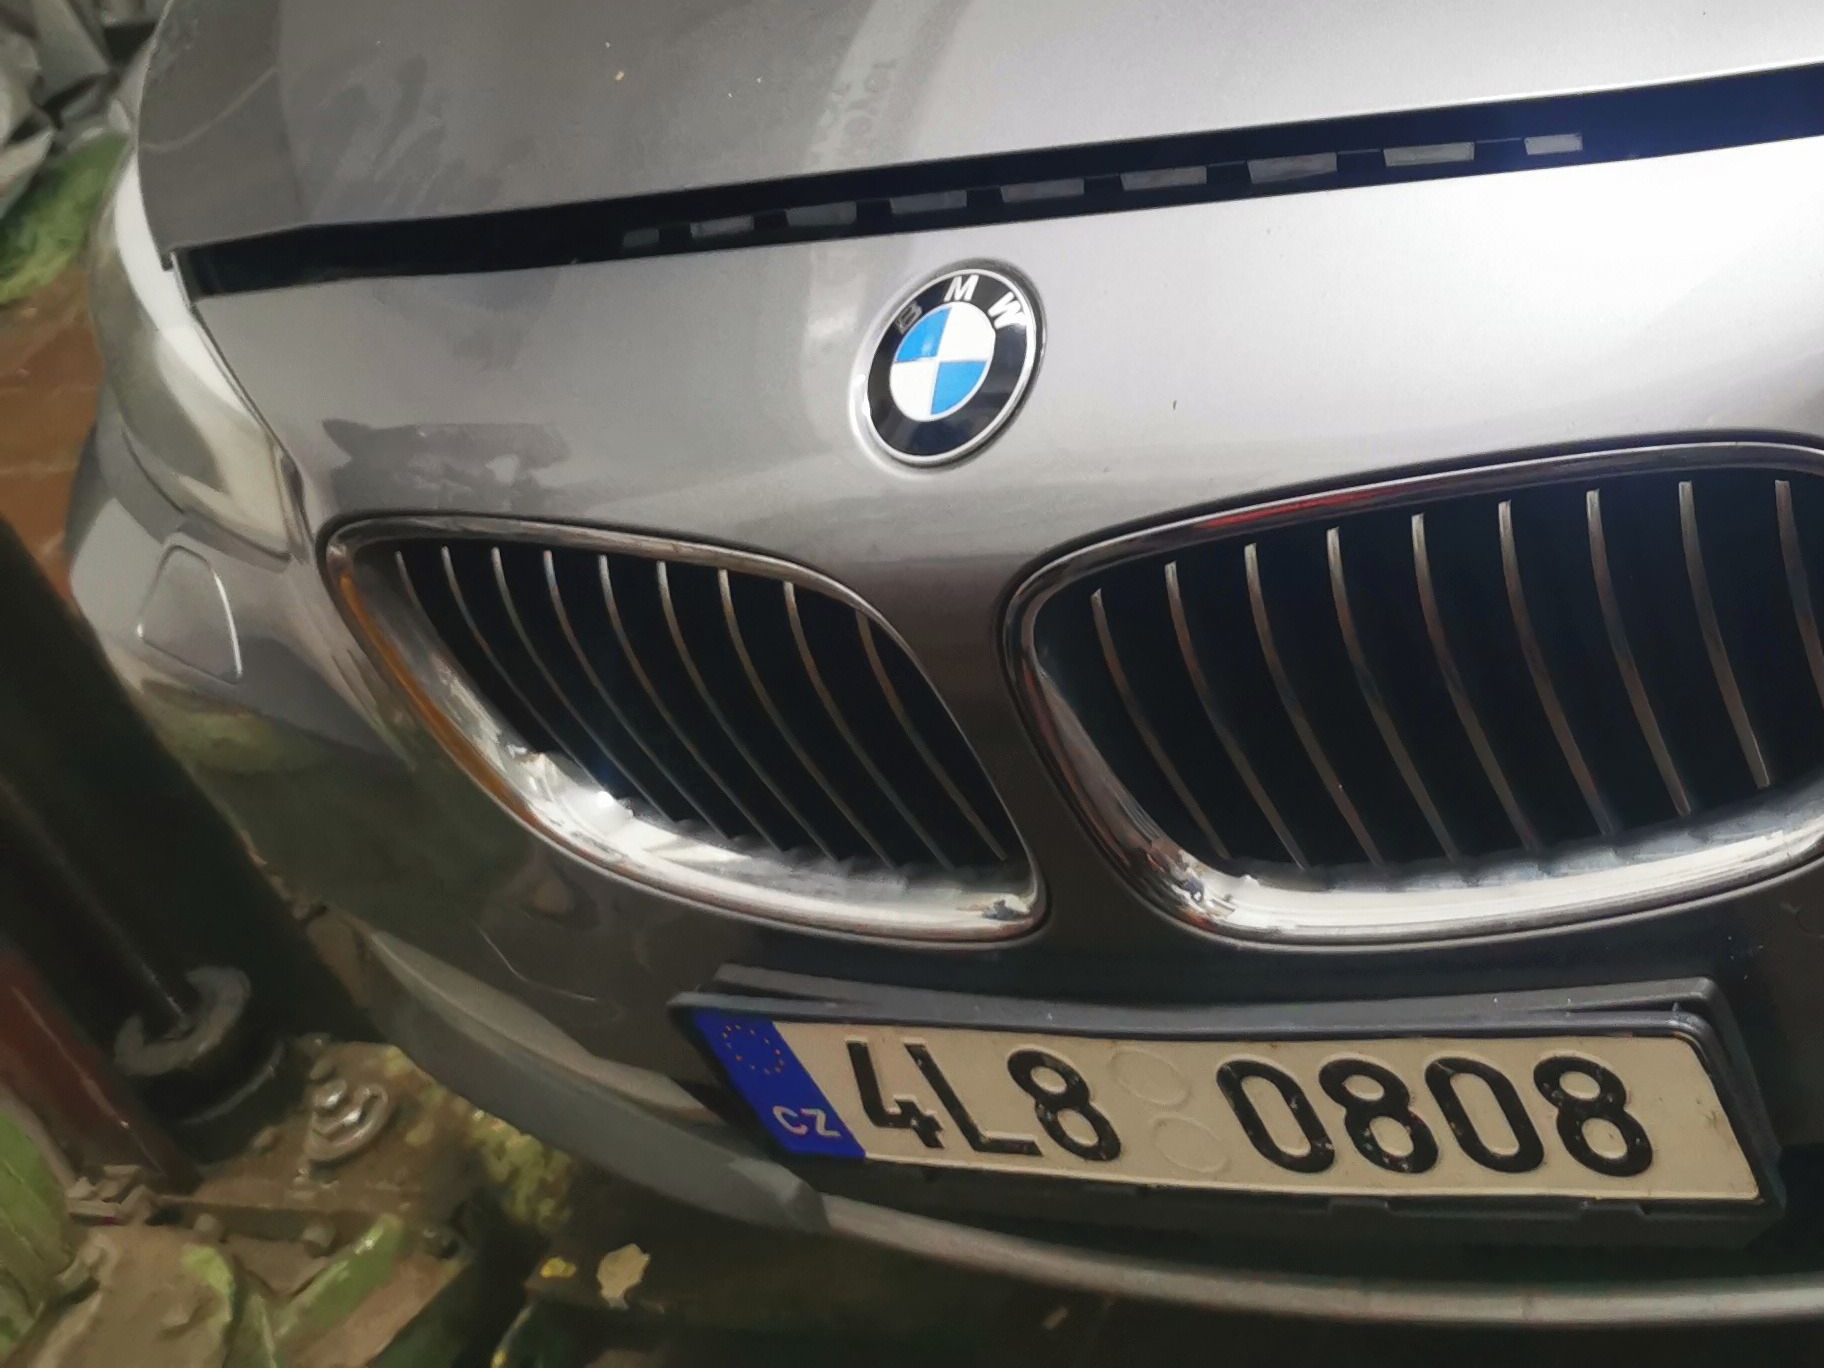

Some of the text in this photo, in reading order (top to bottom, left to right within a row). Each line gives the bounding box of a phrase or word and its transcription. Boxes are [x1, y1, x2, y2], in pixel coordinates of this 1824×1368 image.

[895, 272, 1027, 336] BMW
[772, 1104, 842, 1143] CZ
[846, 1038, 1655, 1180] 4L8 0808
